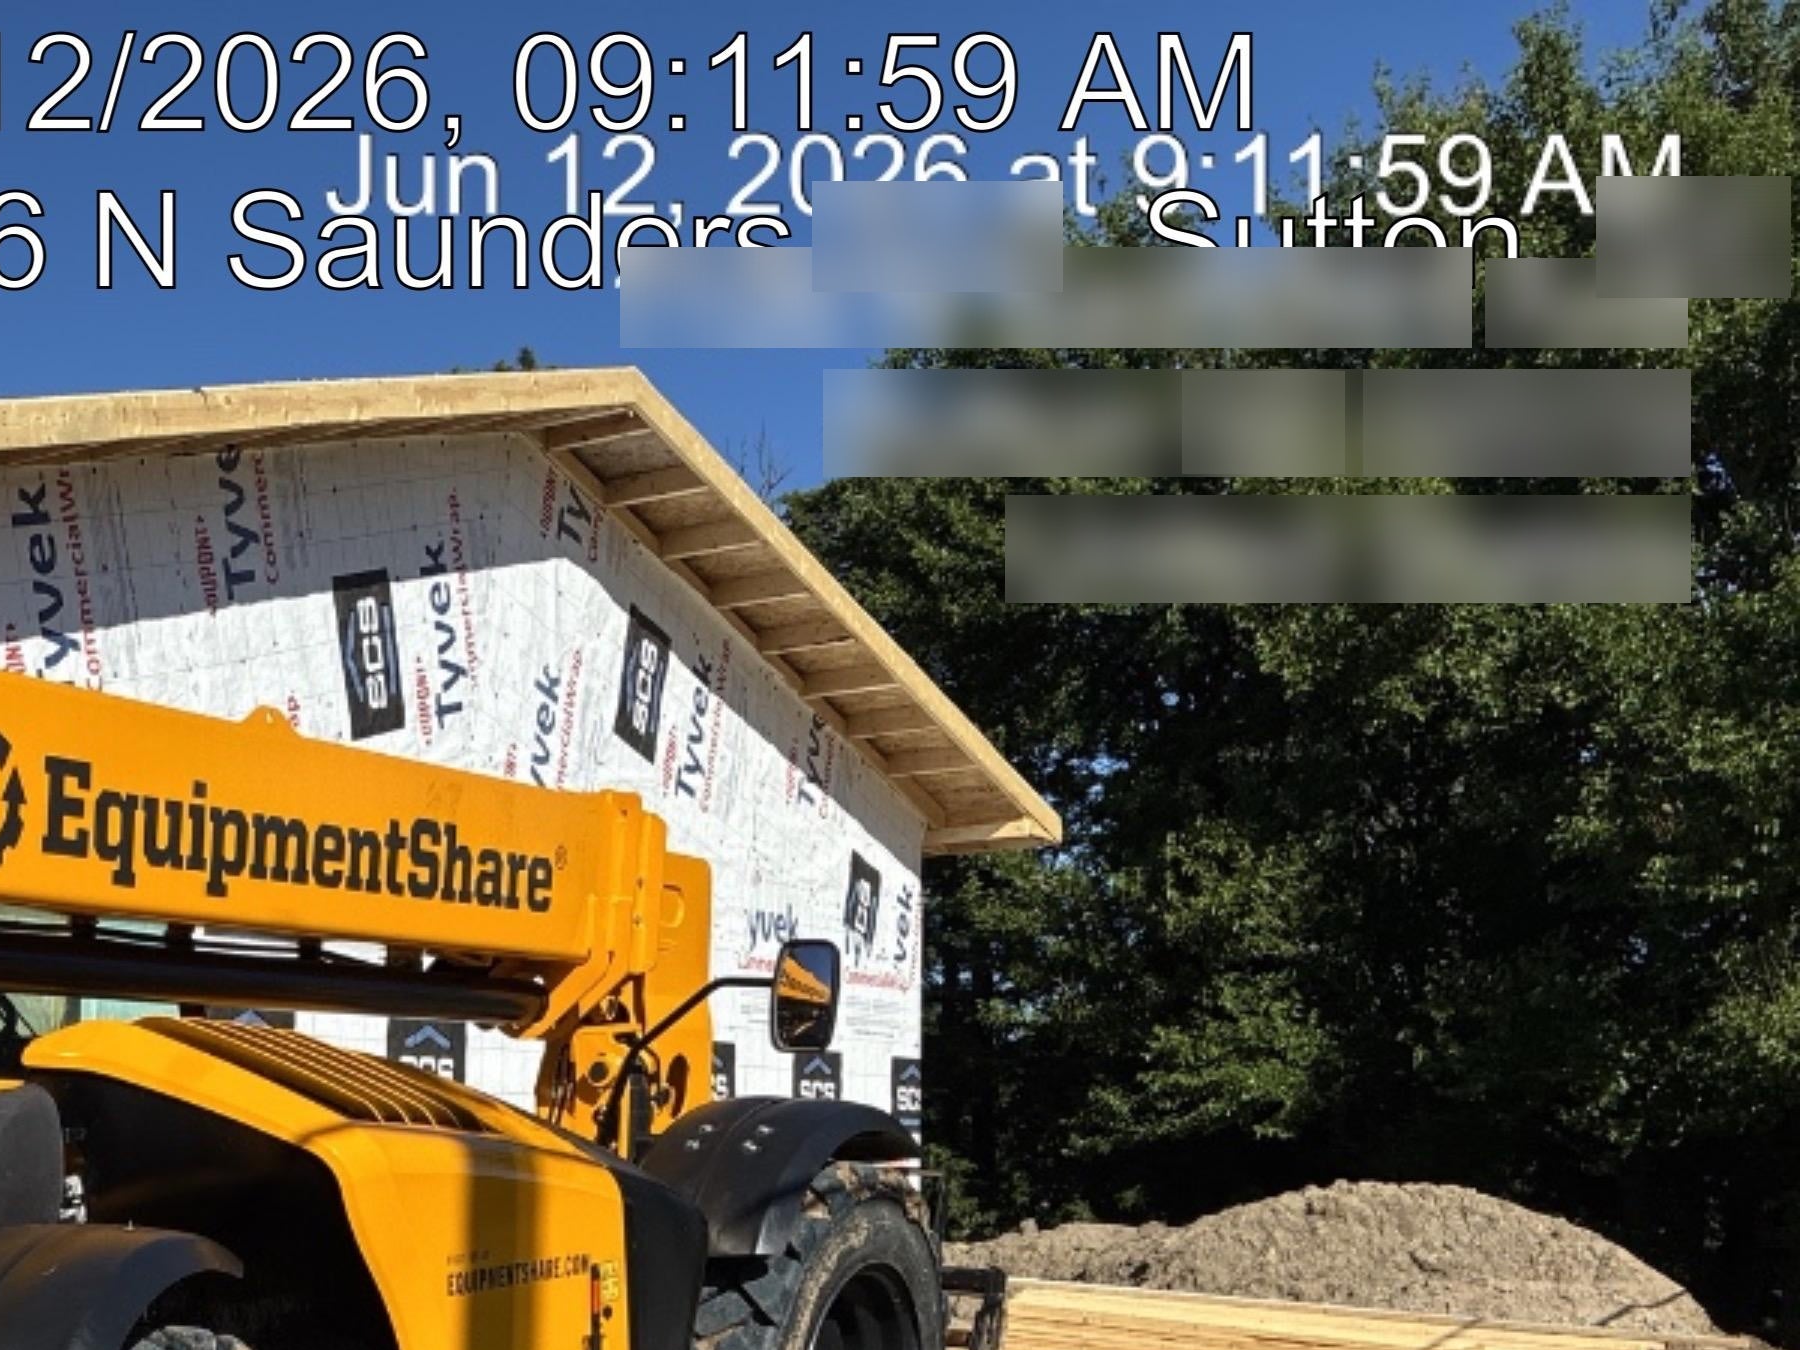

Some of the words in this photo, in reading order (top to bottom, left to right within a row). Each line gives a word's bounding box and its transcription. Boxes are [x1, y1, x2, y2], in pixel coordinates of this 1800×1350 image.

[11, 482, 81, 684] yvek
[419, 540, 469, 730] Tyvek
[674, 653, 713, 799] Tyvek
